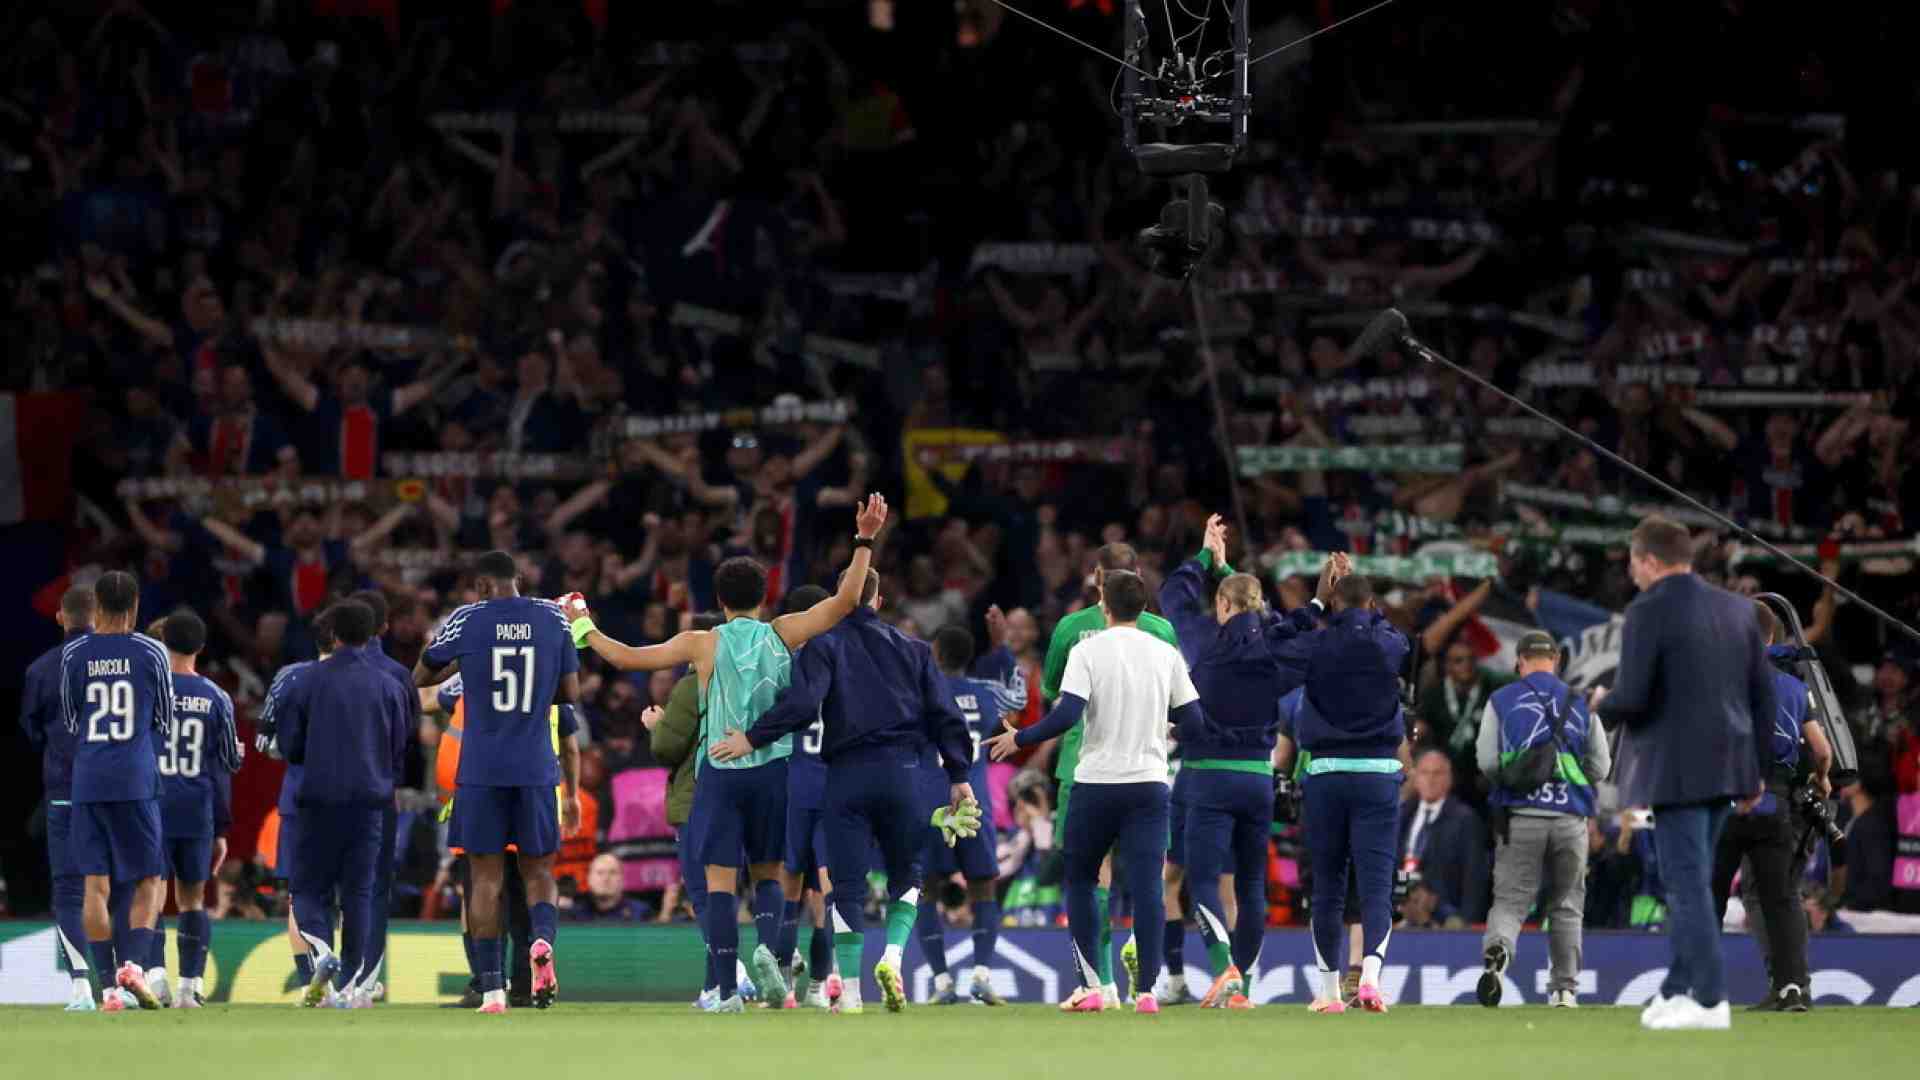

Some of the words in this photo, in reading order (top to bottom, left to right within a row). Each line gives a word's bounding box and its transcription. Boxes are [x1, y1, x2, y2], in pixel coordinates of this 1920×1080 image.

[496, 623, 531, 640] PACHO
[87, 658, 131, 677] BARCOLA
[492, 646, 535, 713] 51
[86, 680, 135, 742] 29
[159, 719, 204, 777] 33
